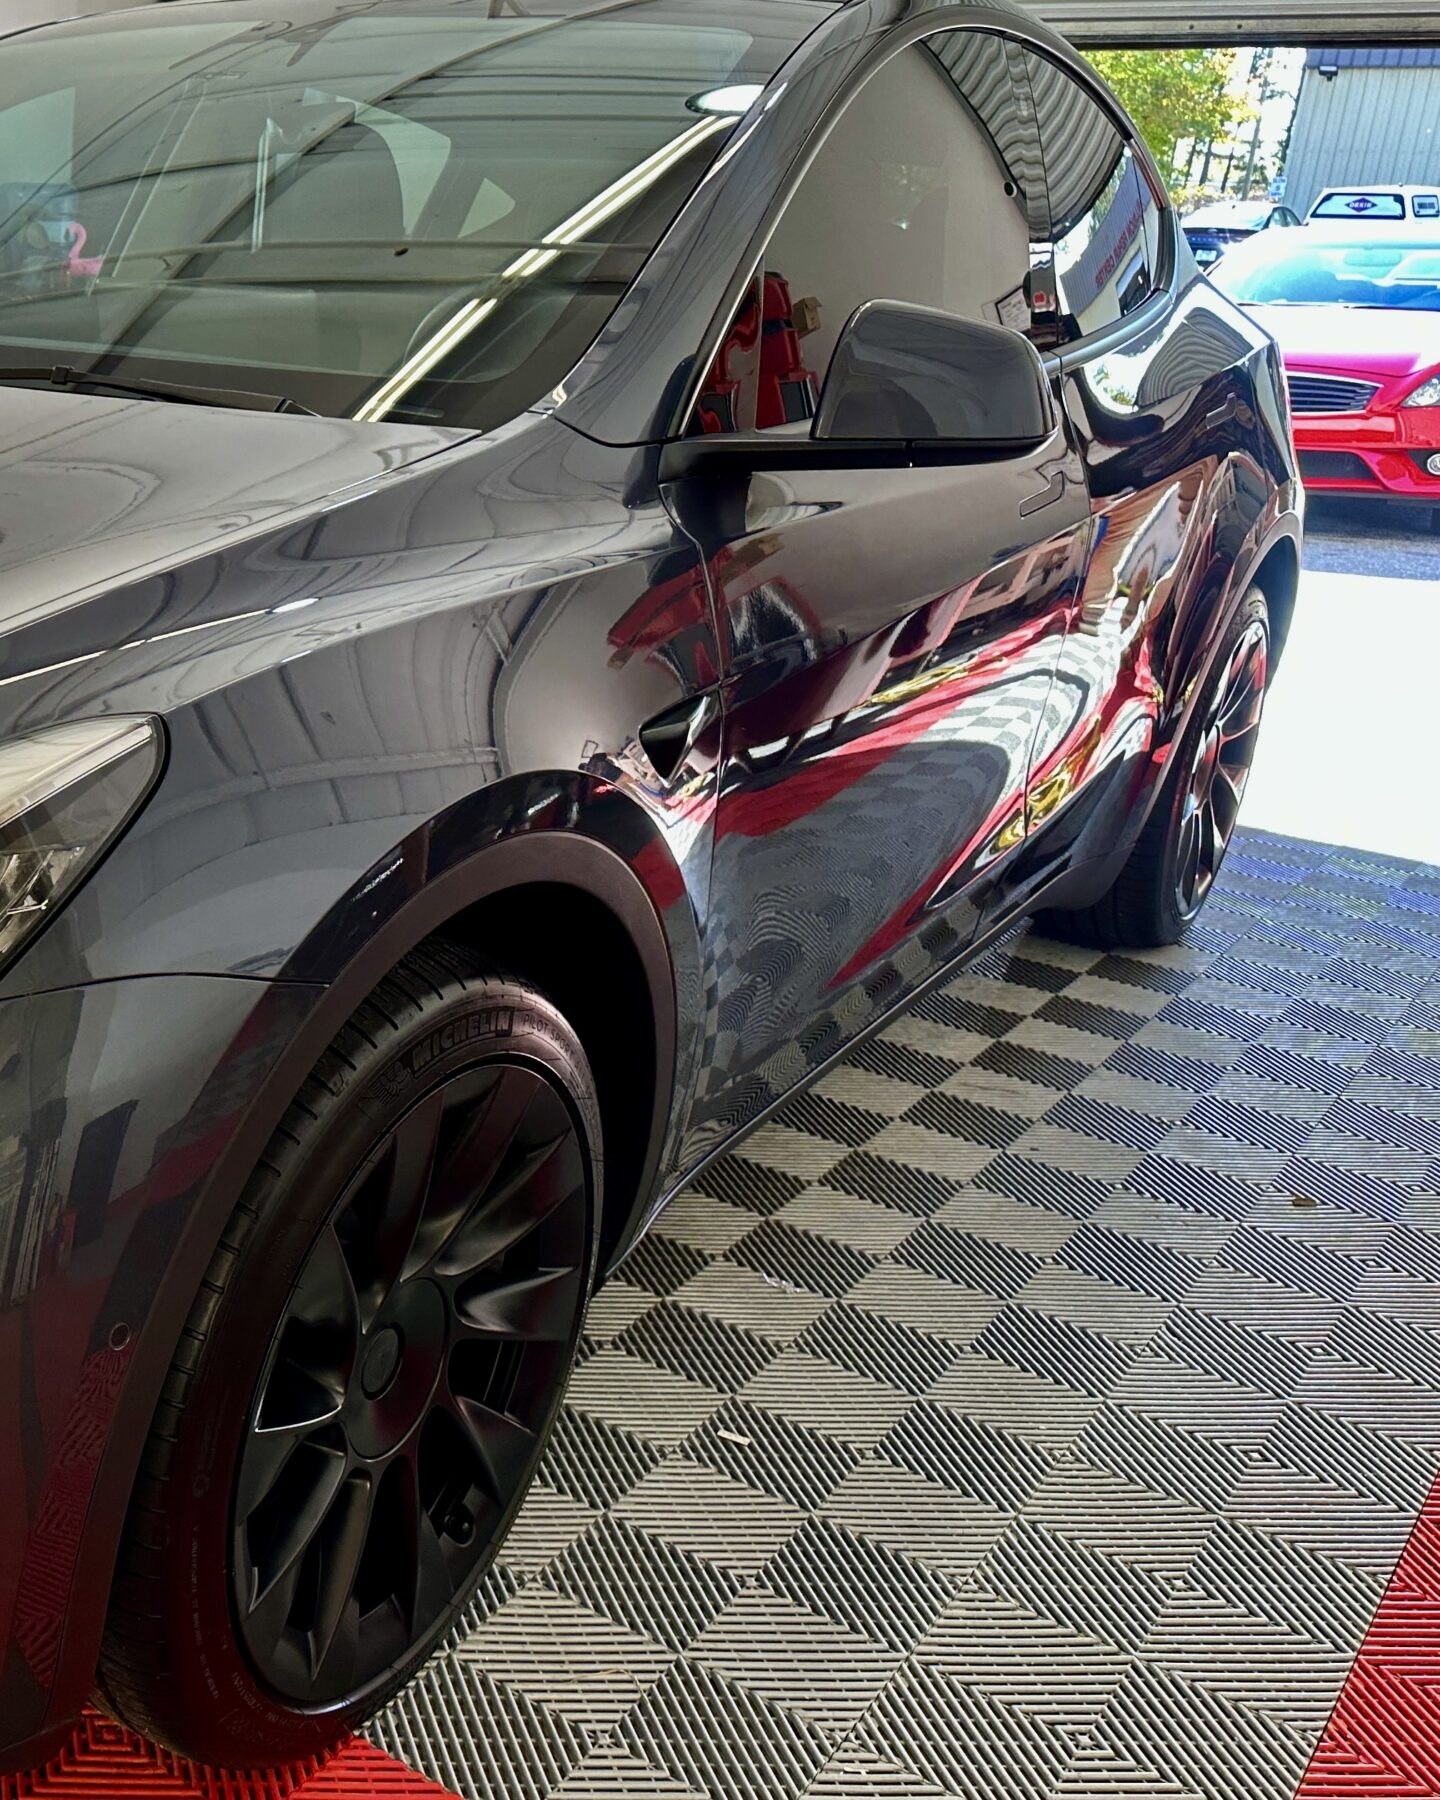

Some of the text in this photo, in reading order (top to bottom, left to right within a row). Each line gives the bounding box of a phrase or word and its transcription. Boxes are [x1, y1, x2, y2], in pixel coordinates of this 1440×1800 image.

[1349, 201, 1372, 209] ORKIN
[411, 1008, 512, 1075] MICHELIN
[523, 1012, 549, 1034] PILOT
